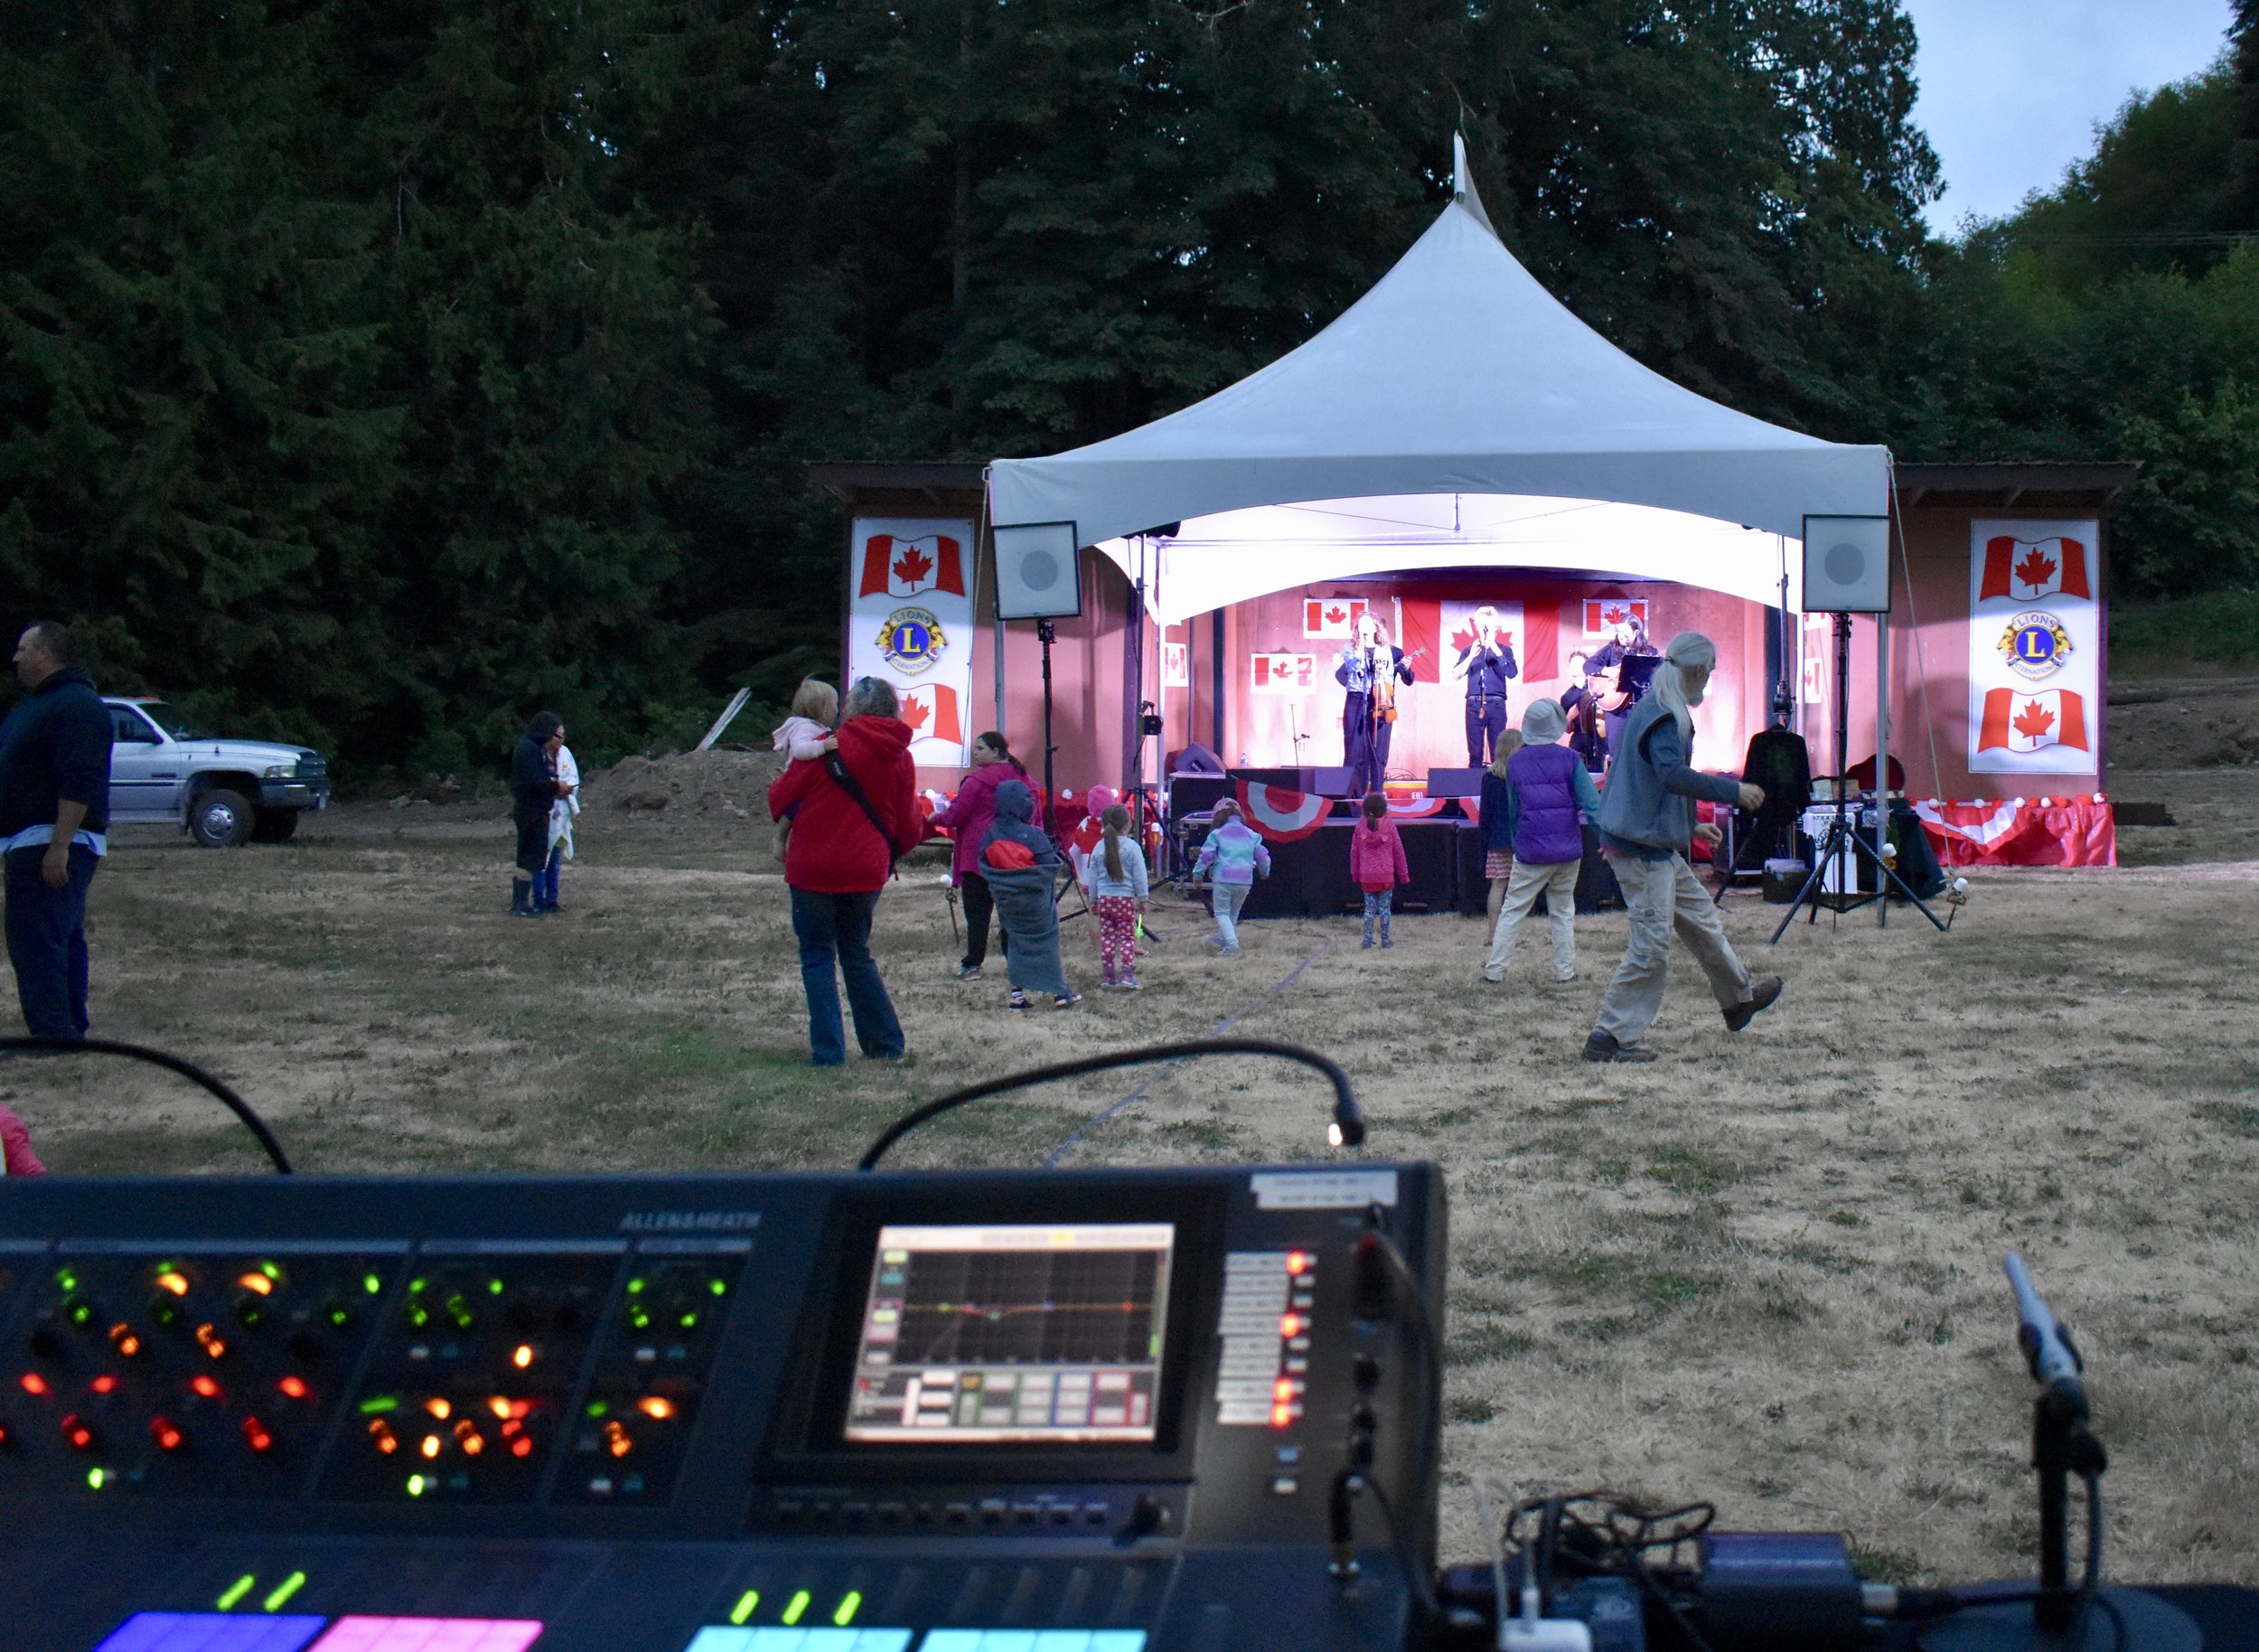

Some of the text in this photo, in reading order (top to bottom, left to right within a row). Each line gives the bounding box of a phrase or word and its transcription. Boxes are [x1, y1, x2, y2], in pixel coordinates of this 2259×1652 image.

[894, 610, 931, 624] LIONS
[2017, 614, 2056, 628] LIONS
[902, 627, 922, 653] L
[2025, 632, 2047, 658] L
